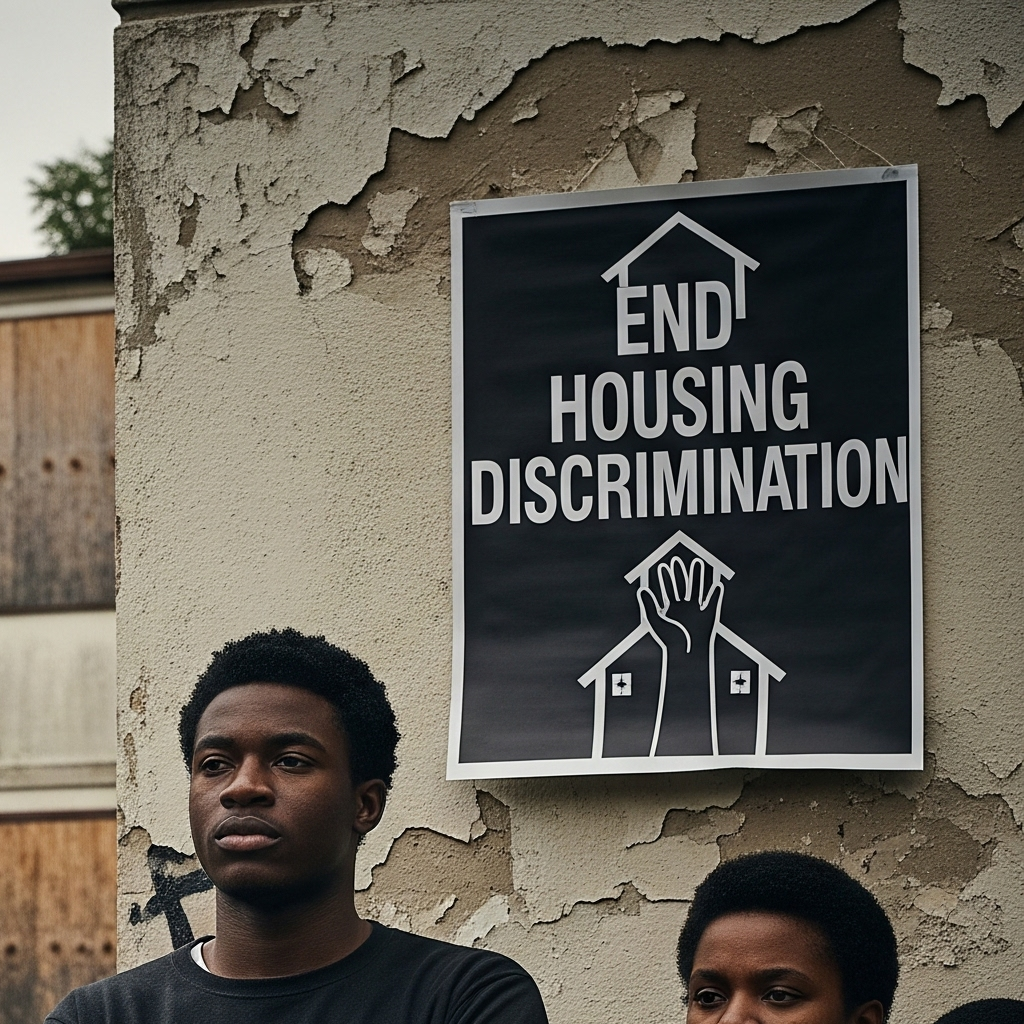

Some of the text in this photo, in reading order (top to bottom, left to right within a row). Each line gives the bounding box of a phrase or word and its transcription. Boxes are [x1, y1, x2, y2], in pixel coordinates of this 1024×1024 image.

[616, 280, 733, 356] END
[550, 360, 810, 443] HOUSING
[470, 436, 909, 526] DISCRIMINATION
